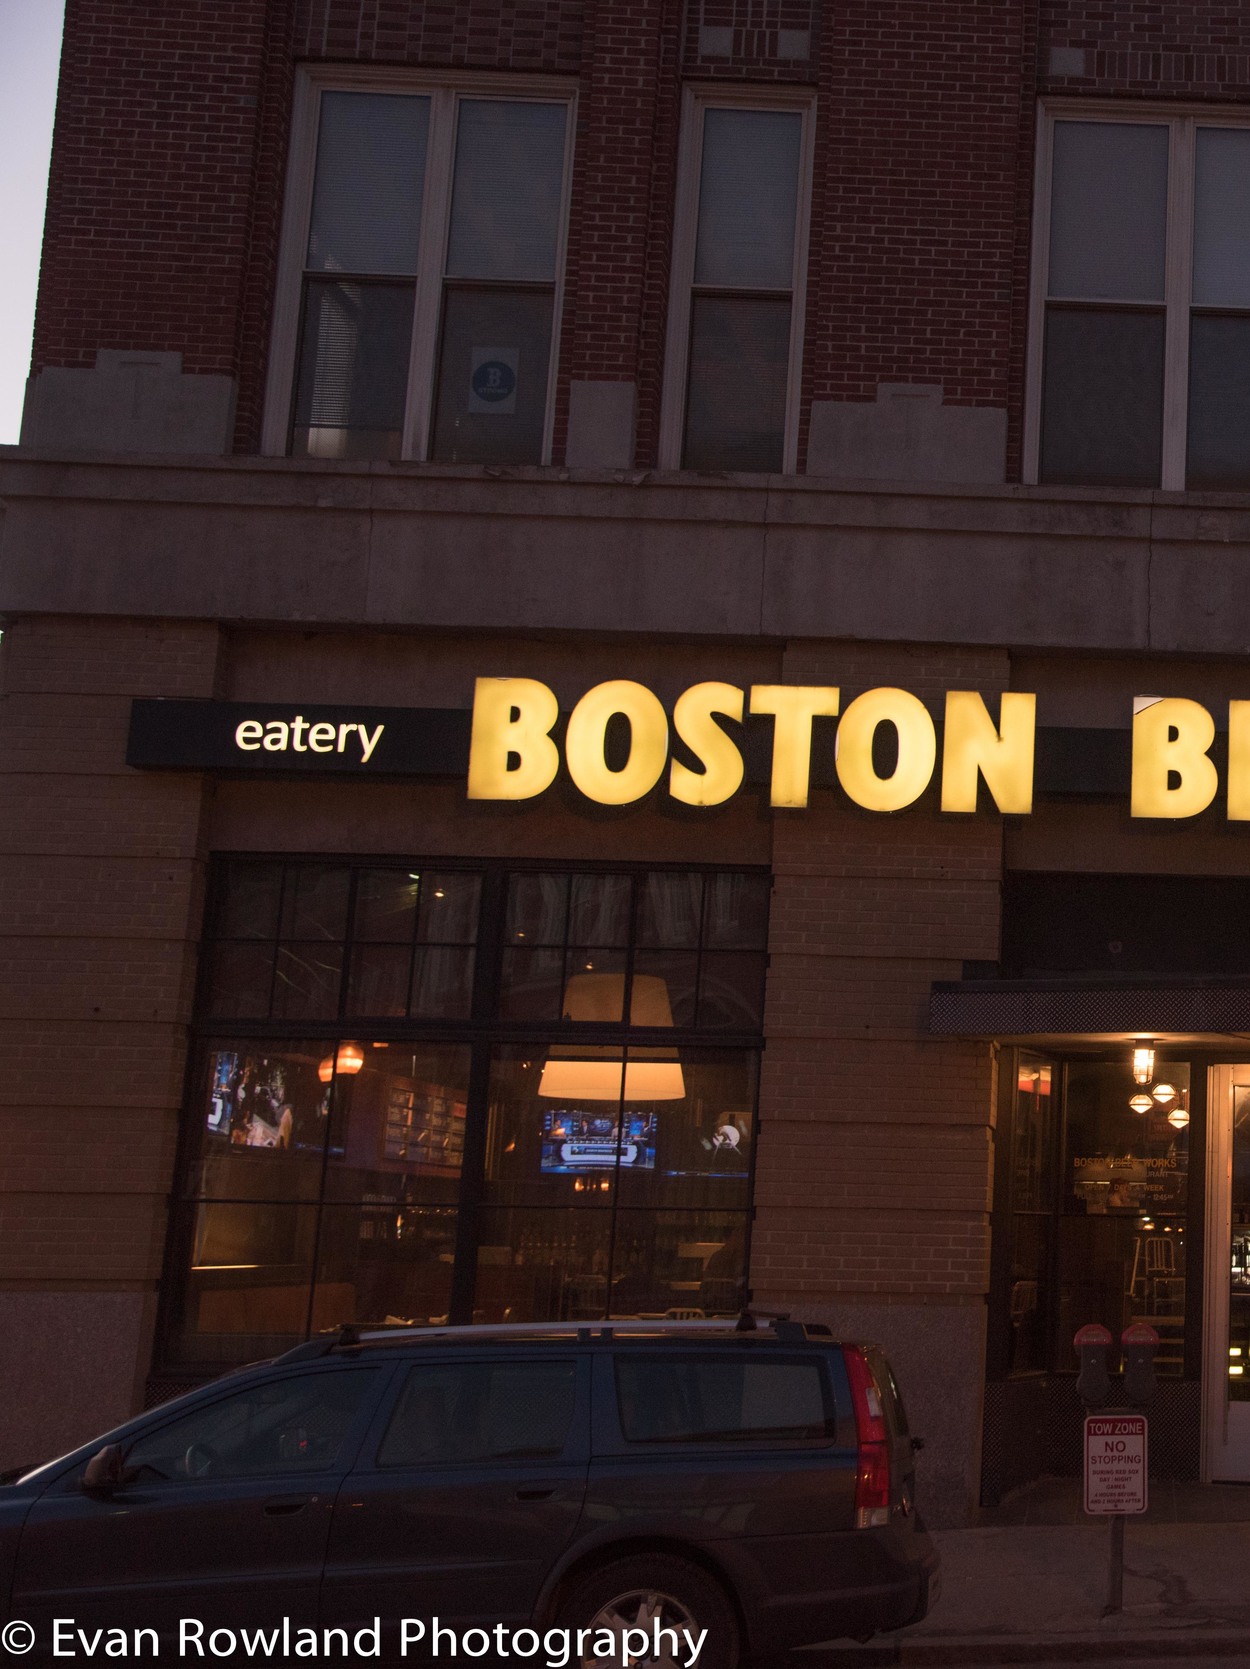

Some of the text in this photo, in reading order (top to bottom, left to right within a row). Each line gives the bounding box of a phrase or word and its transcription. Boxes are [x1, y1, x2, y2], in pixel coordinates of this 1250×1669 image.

[235, 715, 385, 763] eatery
[467, 677, 1037, 814] BOSTON
[1143, 1158, 1177, 1168] WORKS
[1143, 1184, 1165, 1192] WEEK
[1089, 1422, 1143, 1434] TOW ZONE
[1105, 1440, 1126, 1453] NO
[1090, 1455, 1142, 1465] STOPPING
